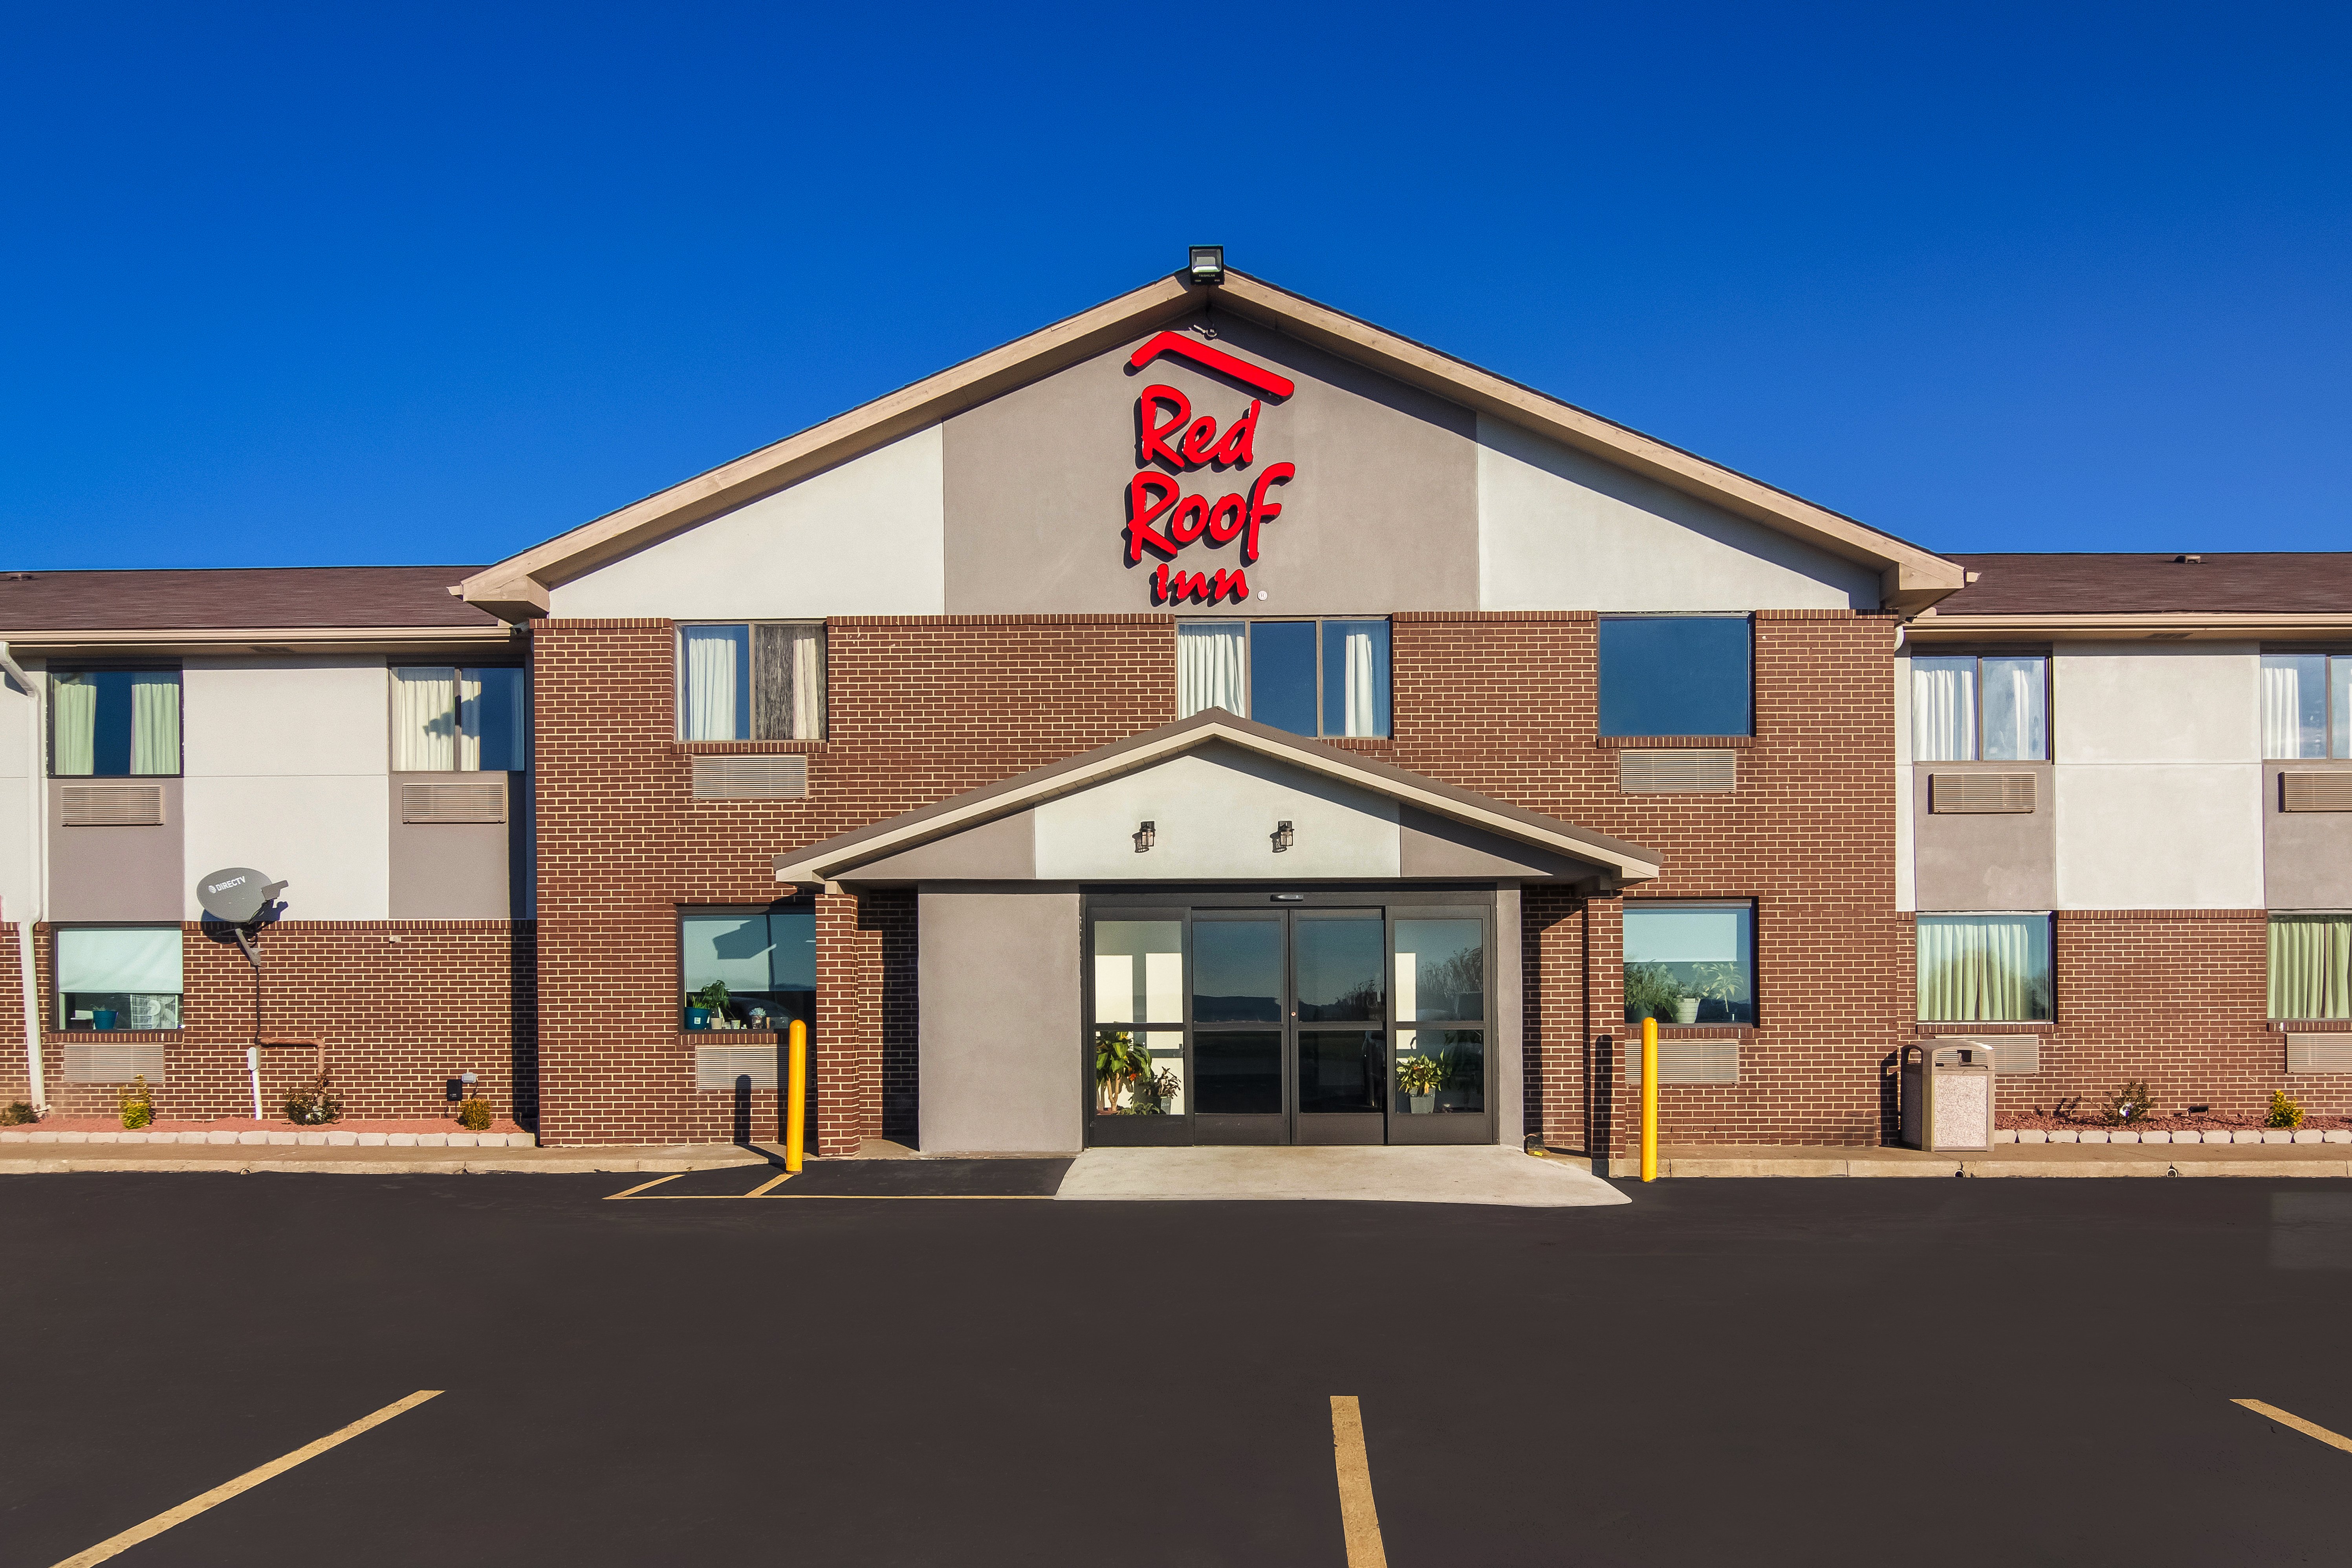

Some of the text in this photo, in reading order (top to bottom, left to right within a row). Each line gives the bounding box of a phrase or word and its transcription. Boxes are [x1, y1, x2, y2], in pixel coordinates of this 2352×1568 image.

[1141, 385, 1261, 467] Red
[1128, 462, 1295, 561] Roof
[215, 876, 245, 891] DIRECTV
